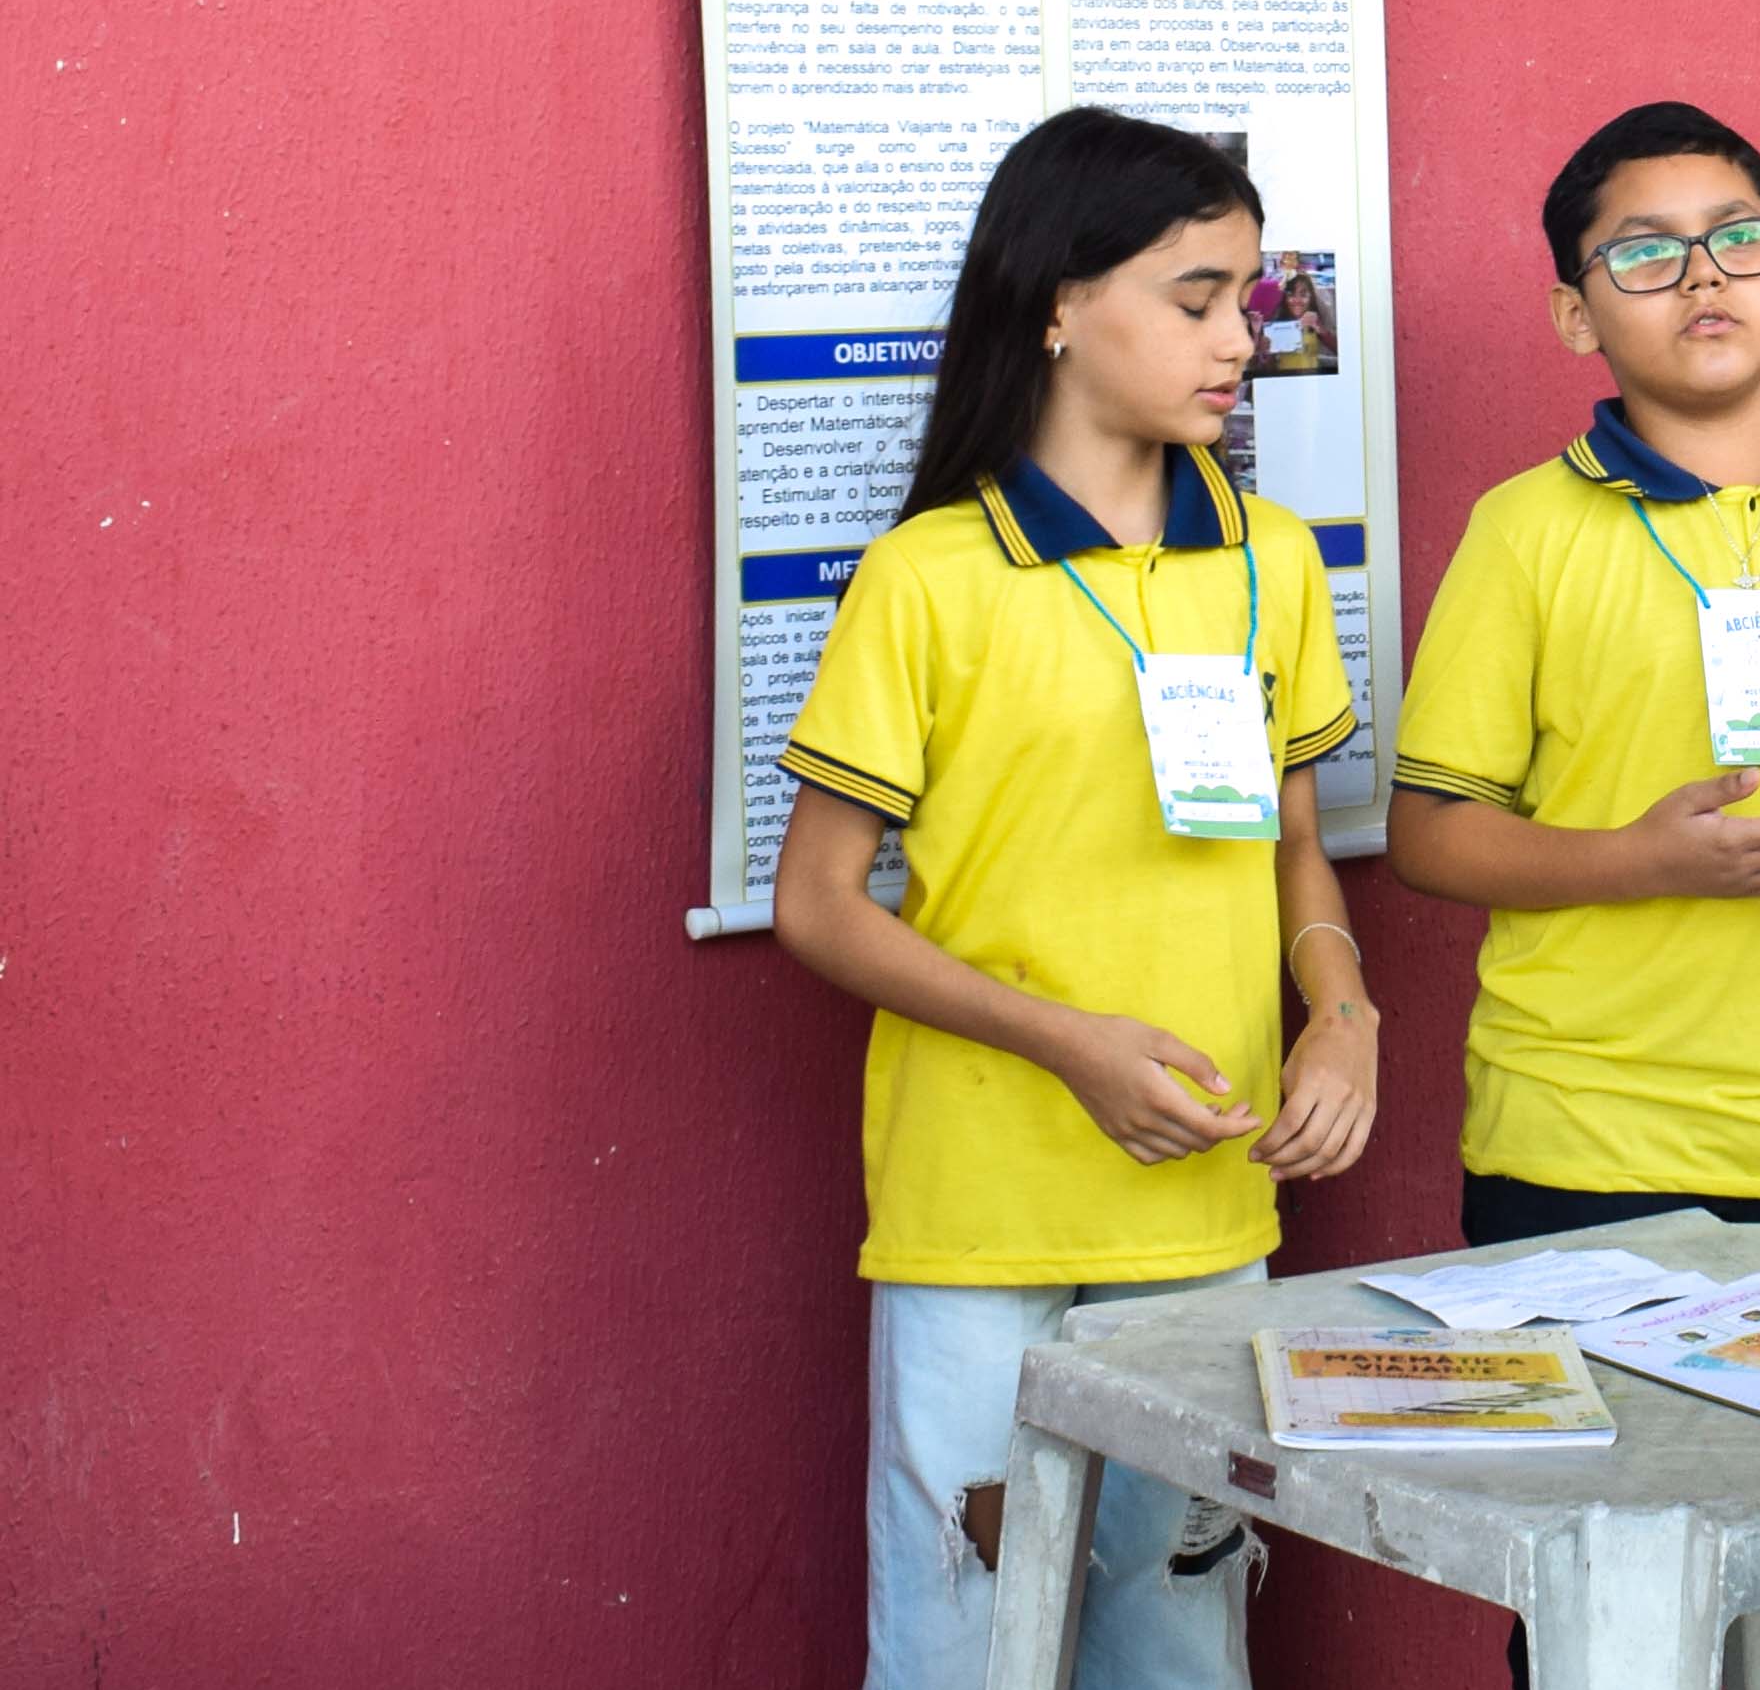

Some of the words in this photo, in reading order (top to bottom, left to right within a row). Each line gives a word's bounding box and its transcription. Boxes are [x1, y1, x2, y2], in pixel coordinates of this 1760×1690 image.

[727, 1, 809, 17] insegurança
[850, 1, 879, 15] falta
[1017, 4, 1038, 17] que
[726, 20, 781, 34] interfere
[819, 23, 845, 34] seu
[855, 21, 943, 37] desempenho
[952, 24, 999, 35] escolar
[1070, 16, 1140, 30] atividades
[1149, 18, 1213, 33] propostas
[1237, 19, 1264, 33] pela
[1272, 18, 1349, 36] participação
[848, 43, 876, 54] sala
[952, 41, 995, 54] Diante
[1004, 42, 1039, 55] dessa
[1072, 39, 1104, 51] ativa
[1136, 39, 1169, 51] cada
[727, 61, 789, 74] realidade
[900, 62, 930, 74] criar
[938, 62, 1010, 77] estratégias
[1018, 63, 1040, 76] que
[1072, 57, 1151, 76] significativo
[1157, 61, 1204, 75] avanço
[1313, 62, 1350, 73] como
[791, 80, 878, 95] aprendizado
[882, 83, 914, 93] mais
[1072, 79, 1128, 93] também
[1134, 81, 1188, 93] atitudes
[1275, 80, 1351, 97] cooperação
[747, 122, 795, 137] projeto
[897, 119, 952, 136] Viajante
[985, 118, 1022, 132] Trilha
[815, 143, 855, 157] surge
[878, 142, 916, 153] como
[938, 142, 967, 152] uma
[822, 163, 849, 176] que
[899, 162, 944, 173] ensino
[949, 159, 974, 172] dos
[731, 181, 815, 195] matemáticos
[835, 179, 914, 196] valorização
[751, 200, 833, 217] cooperação
[876, 200, 932, 214] respeito
[757, 221, 827, 235] atividades
[732, 242, 771, 255] metas
[859, 238, 942, 255] pretende-se
[733, 265, 768, 279] gosto
[773, 261, 804, 278] pela
[810, 259, 876, 276] disciplina
[751, 280, 829, 299] esforçarem
[832, 282, 865, 296] para
[869, 277, 929, 295] alcançar
[757, 396, 834, 413] Despertar
[737, 418, 805, 436] aprender
[763, 440, 863, 457] Desenvolver
[739, 466, 798, 485] atenção
[763, 488, 836, 503] Estimular
[869, 485, 902, 498] bom
[740, 515, 799, 531] respeito
[835, 507, 900, 526] coopera
[740, 611, 774, 629] Após
[785, 607, 827, 624] iniciar
[740, 630, 788, 650] tópicos
[741, 652, 768, 667] sala
[771, 650, 789, 665] de
[767, 671, 815, 687] projeto
[742, 690, 804, 707] semestre
[742, 713, 759, 727] de
[766, 711, 798, 724] form
[745, 769, 782, 787] Cada
[745, 794, 775, 807] uma
[747, 851, 773, 869] Por
